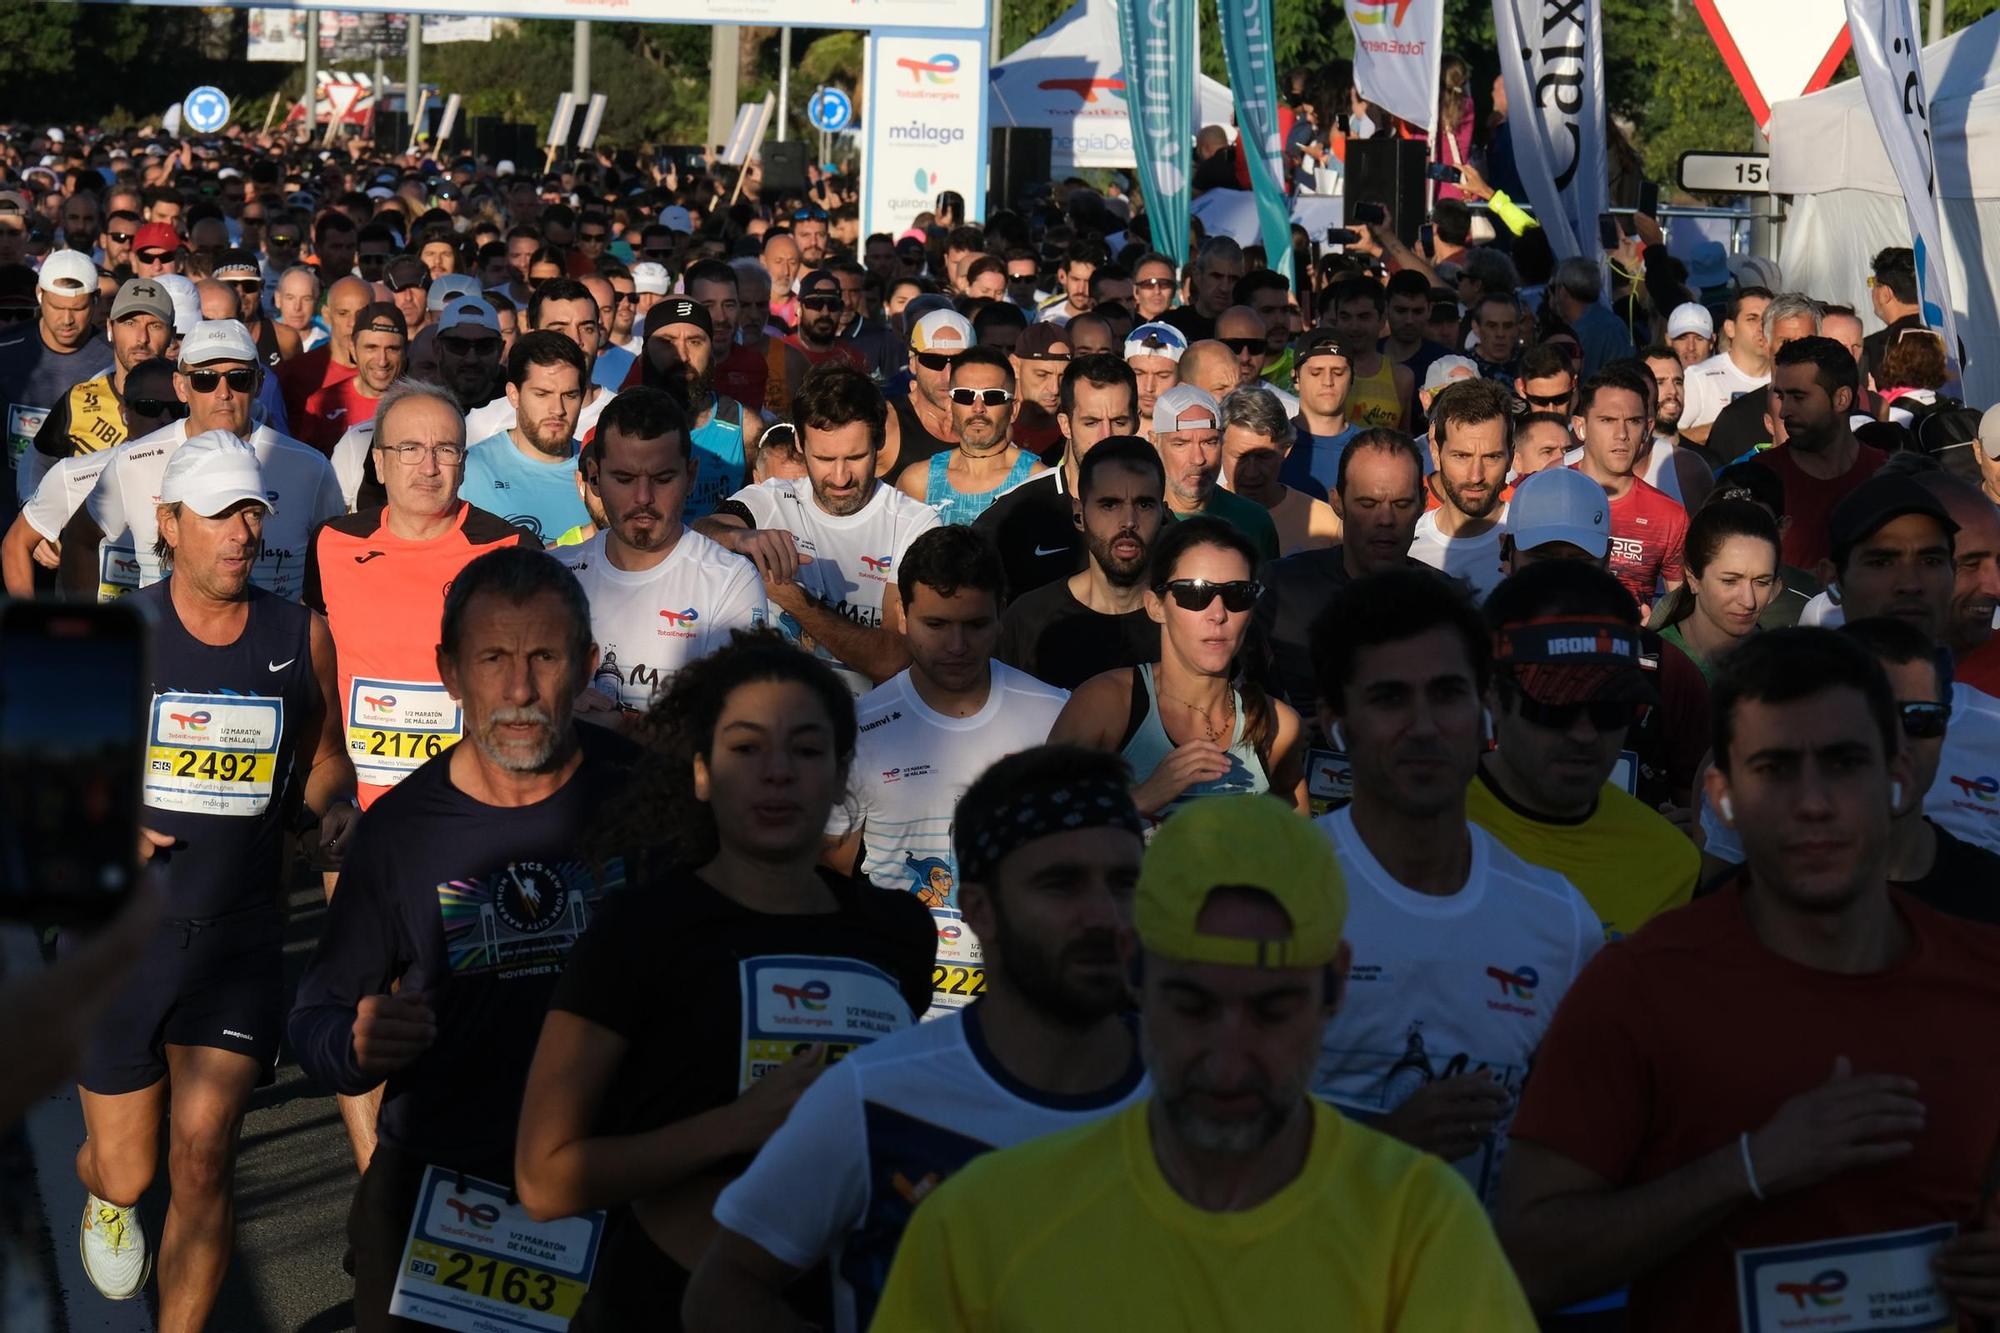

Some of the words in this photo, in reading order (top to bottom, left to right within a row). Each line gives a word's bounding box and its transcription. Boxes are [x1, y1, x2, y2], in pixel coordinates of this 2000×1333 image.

[1736, 163, 1770, 184] 15
[84, 392, 98, 407] 25
[129, 451, 155, 463] luanvi
[1547, 634, 1630, 657] IRONMAN
[858, 715, 891, 734] luanvi
[370, 730, 442, 760] 2176
[177, 750, 256, 783] 2492
[932, 965, 987, 996] 222
[524, 1234, 567, 1253] MARATÓN
[442, 1251, 557, 1312] 2163
